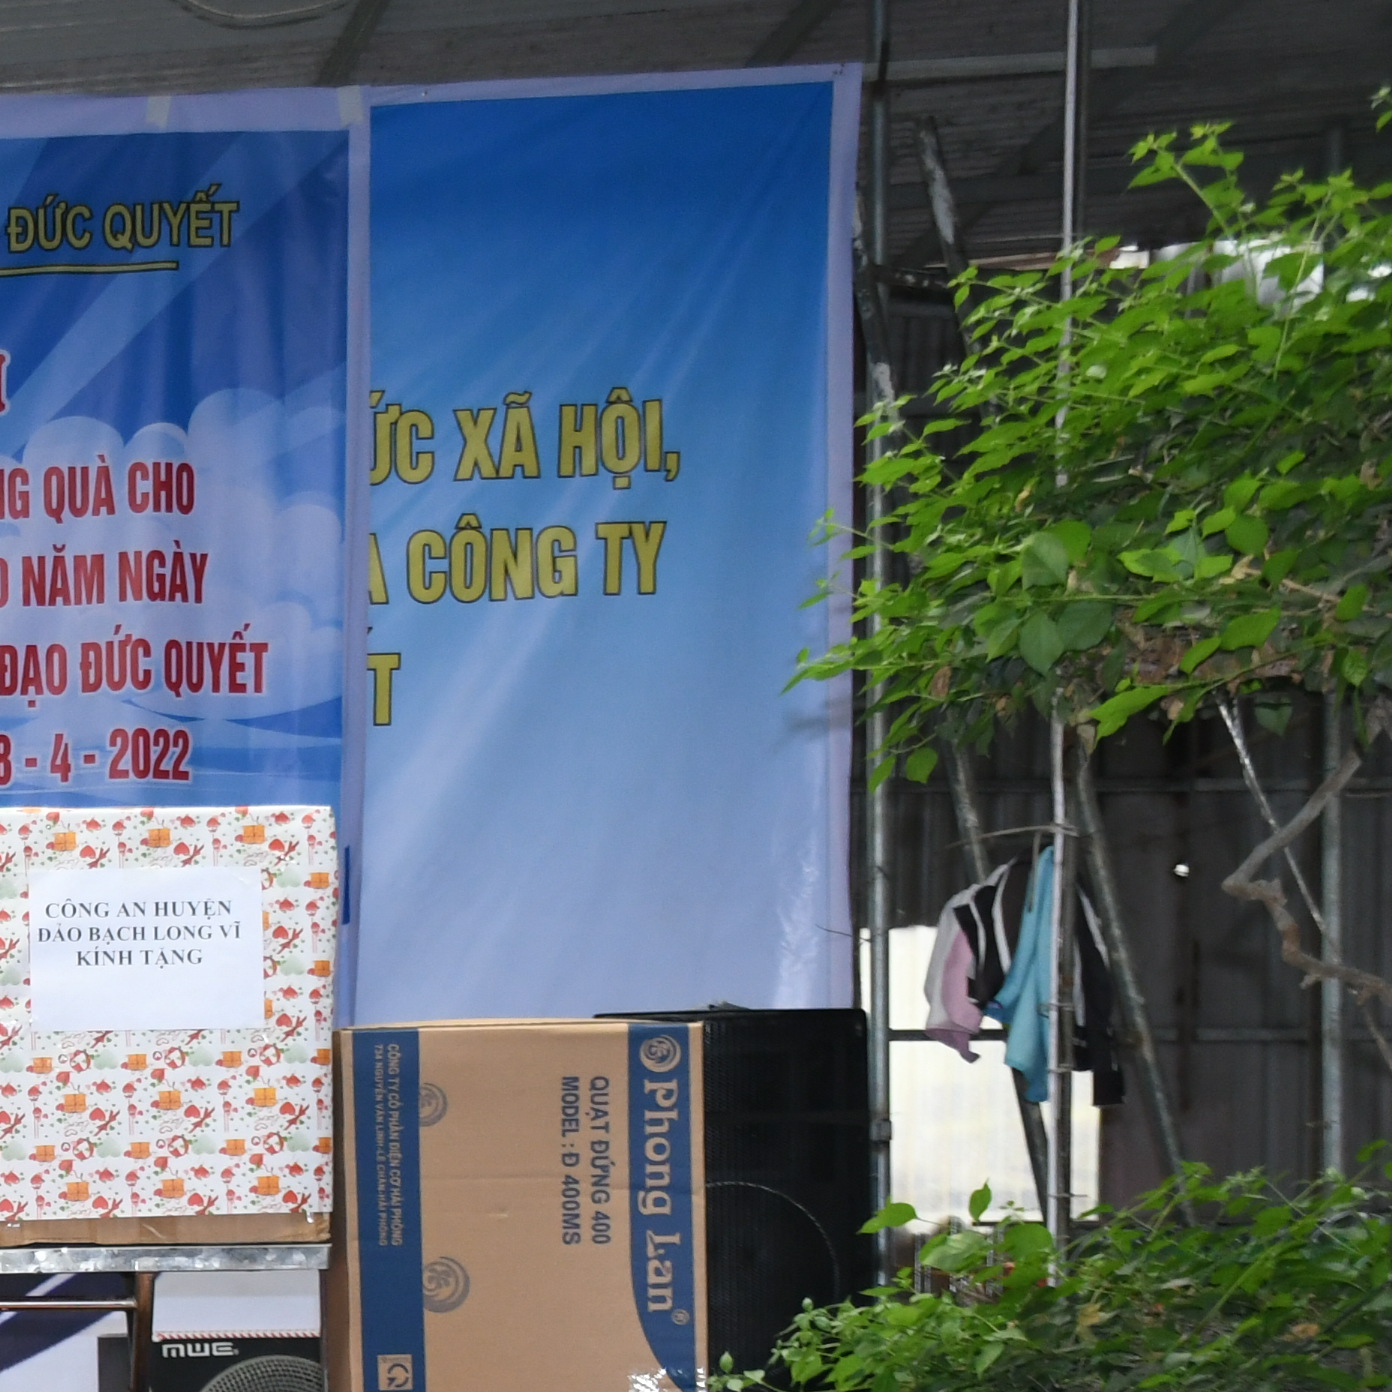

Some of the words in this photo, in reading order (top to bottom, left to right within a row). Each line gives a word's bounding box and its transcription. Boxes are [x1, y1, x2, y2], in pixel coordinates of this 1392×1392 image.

[7, 194, 92, 252] ĐỨC
[103, 184, 240, 252] QUYẾT
[453, 391, 541, 480] XÃ
[557, 387, 680, 490] HỘI,
[43, 455, 115, 524] QUÀ
[128, 461, 195, 516] CHO
[21, 543, 105, 607] NĂM
[118, 540, 208, 604] NGÀY
[406, 513, 577, 604] CÔNG
[596, 521, 667, 595] TY
[80, 625, 152, 692] ĐỨC
[164, 623, 269, 694] QUYẾT
[50, 733, 71, 782] 4
[108, 728, 190, 781] 2022
[37, 922, 82, 942] ĐẢO
[89, 926, 146, 946] BẠCH
[153, 925, 212, 940] LONG
[219, 921, 241, 939] VĨ
[45, 898, 109, 919] CÔNG
[116, 902, 147, 918] AN
[154, 898, 232, 920] HUYỆN
[76, 945, 132, 966] KÍNH
[139, 947, 202, 969] TẶNG
[585, 1076, 609, 1133] QUẠT
[591, 1139, 615, 1204] ĐỨNG
[638, 1079, 680, 1215] Phong
[592, 1210, 612, 1244] 400
[645, 1229, 681, 1312] Lan
